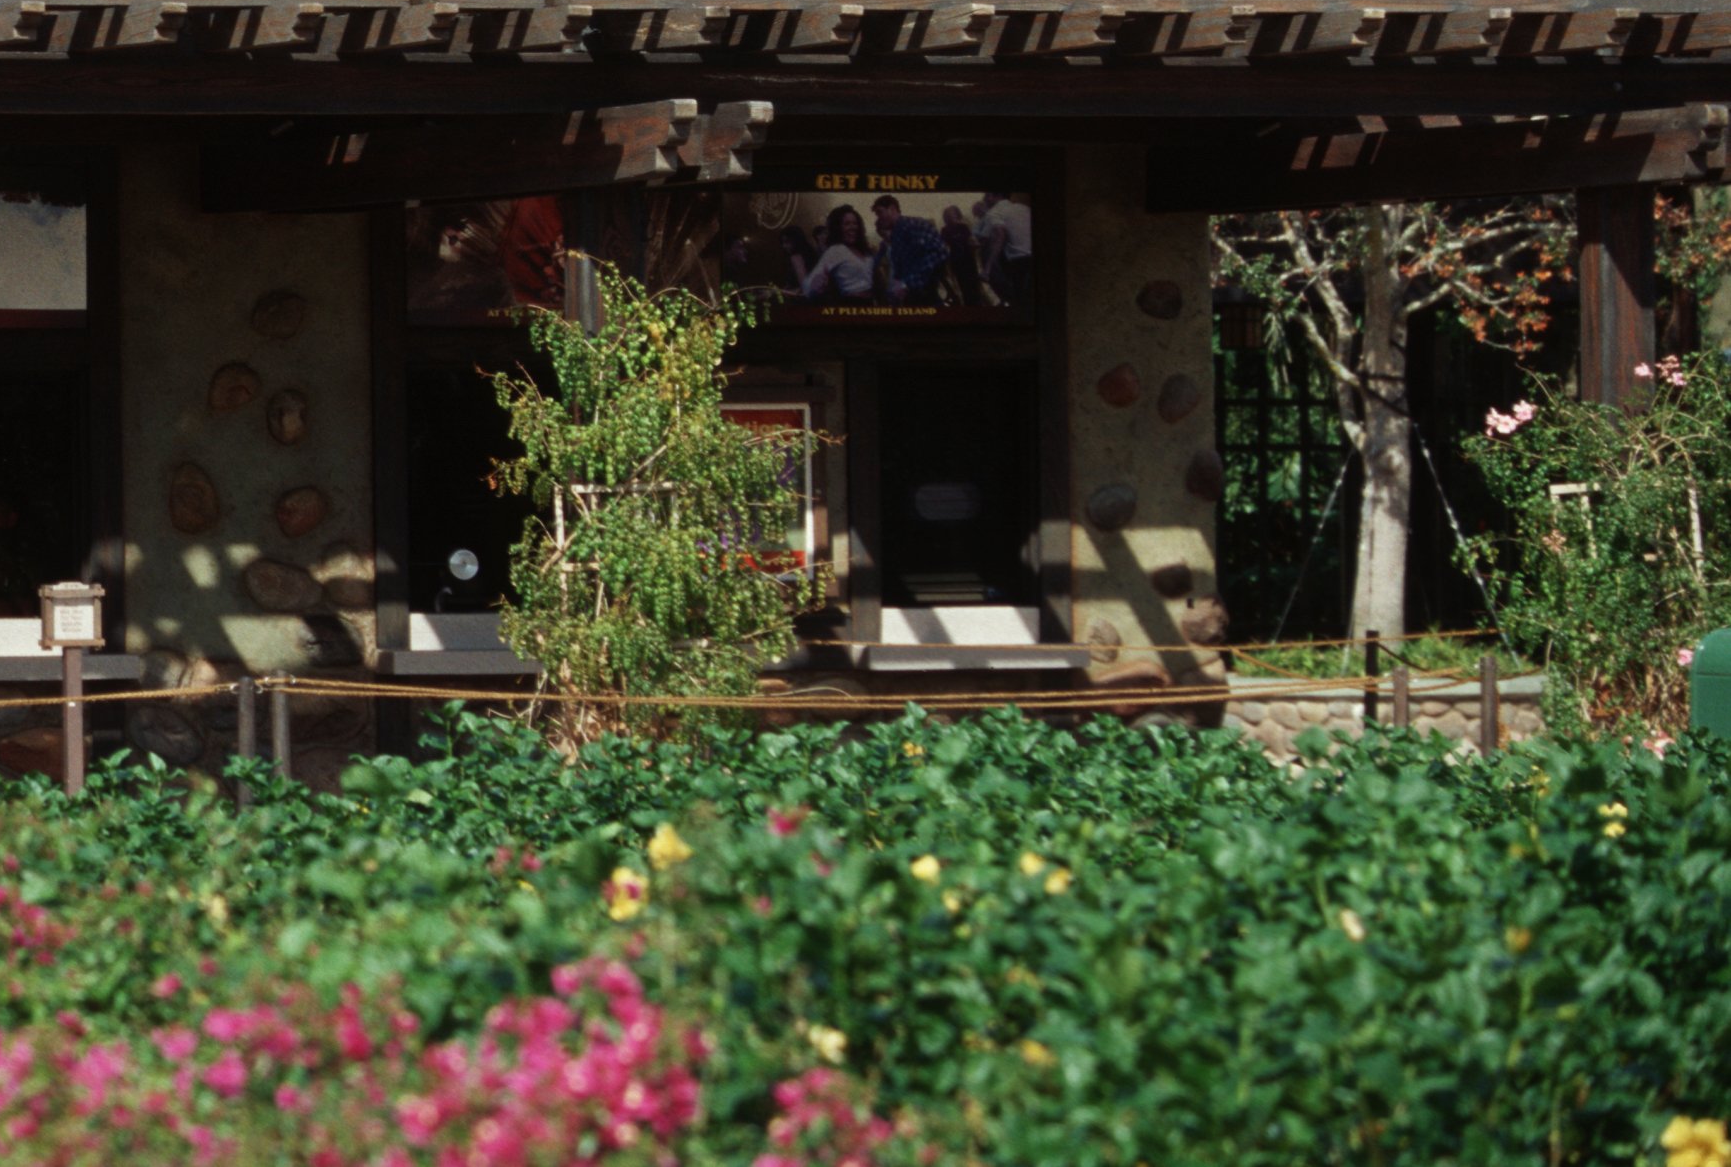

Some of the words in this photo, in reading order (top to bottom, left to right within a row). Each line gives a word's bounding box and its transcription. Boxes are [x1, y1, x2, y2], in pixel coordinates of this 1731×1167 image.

[815, 173, 859, 191] GET
[866, 173, 940, 191] FUNKY
[821, 307, 836, 317] AT
[839, 307, 893, 317] PLEASURE
[897, 307, 938, 317] ISLAND
